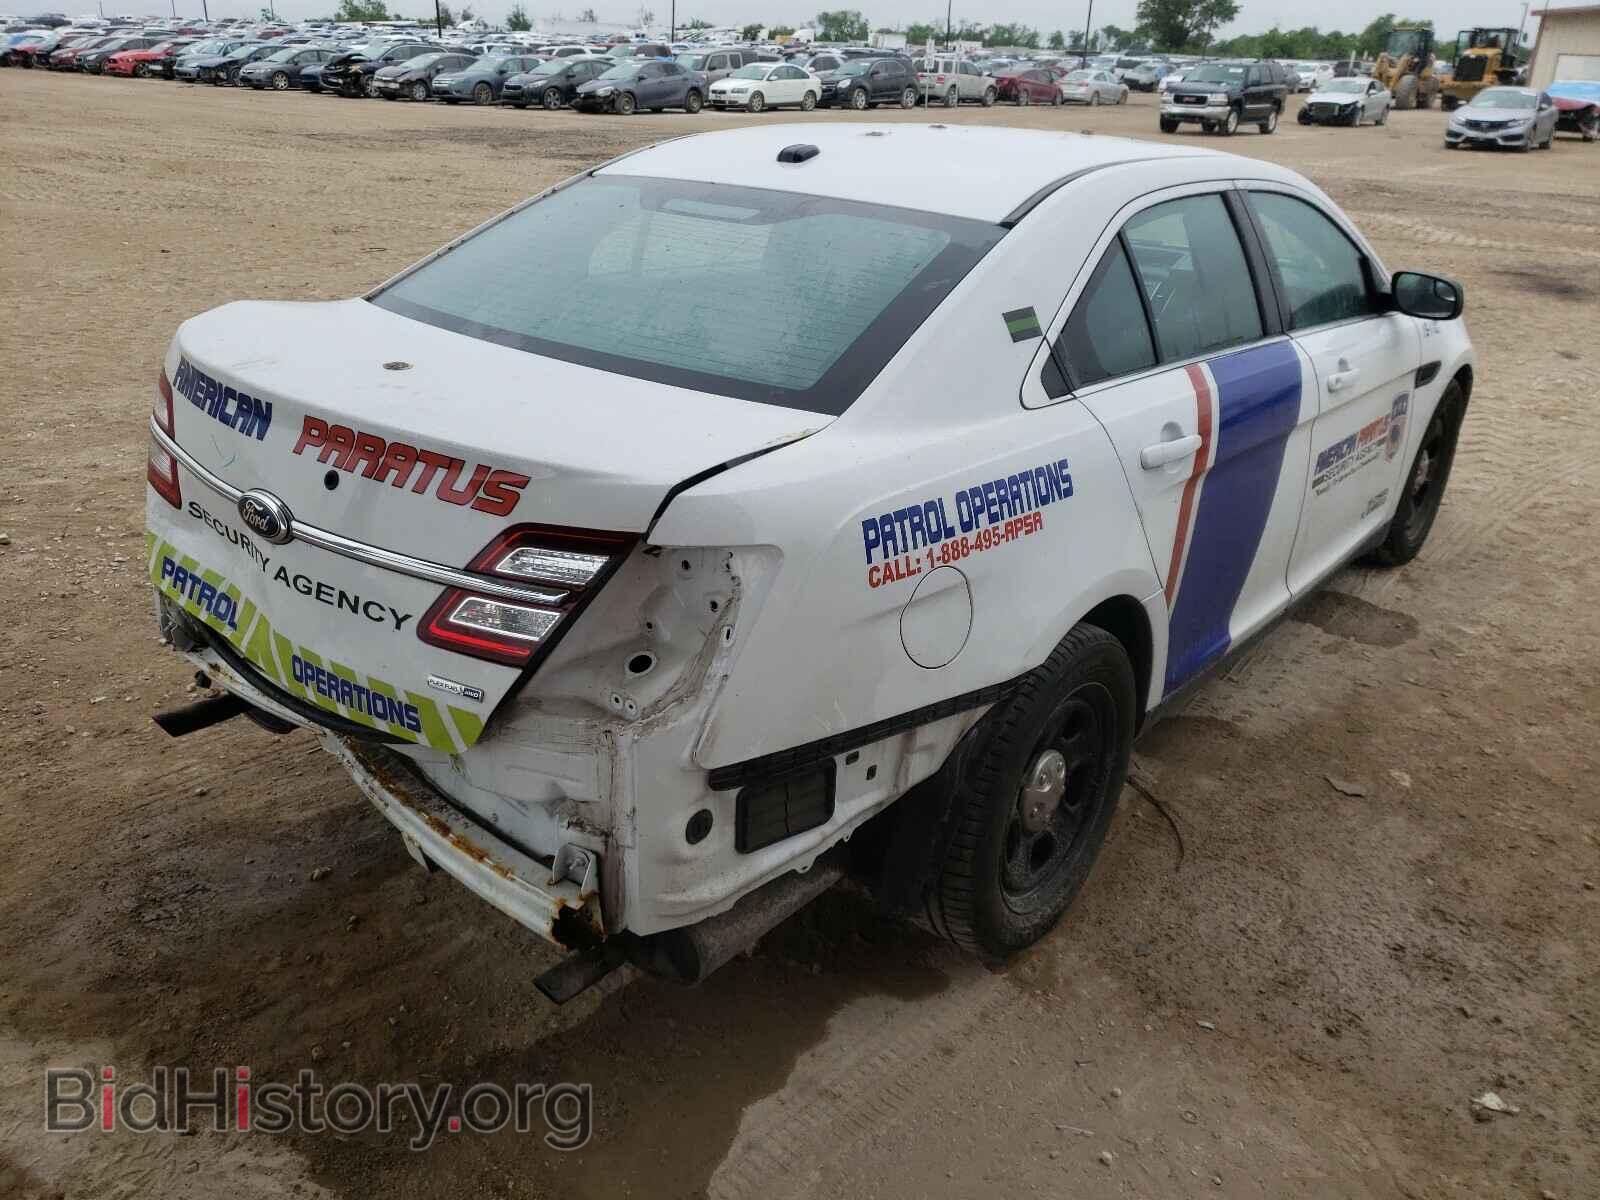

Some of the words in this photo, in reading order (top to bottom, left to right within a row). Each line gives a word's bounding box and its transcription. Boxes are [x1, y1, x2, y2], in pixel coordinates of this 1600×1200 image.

[172, 355, 273, 441] AMERICAN
[293, 414, 531, 518] PARATUS
[188, 501, 270, 573] SECURITY
[273, 565, 413, 631] AGENCY
[243, 500, 269, 529] Ford
[861, 497, 956, 564] PATROL
[955, 458, 1074, 533] OPERATIONS
[868, 556, 922, 588] CALL:
[926, 511, 1044, 568] 1-888-495-APSA
[161, 556, 239, 632] PATROL
[291, 653, 422, 733] OPERATIONS
